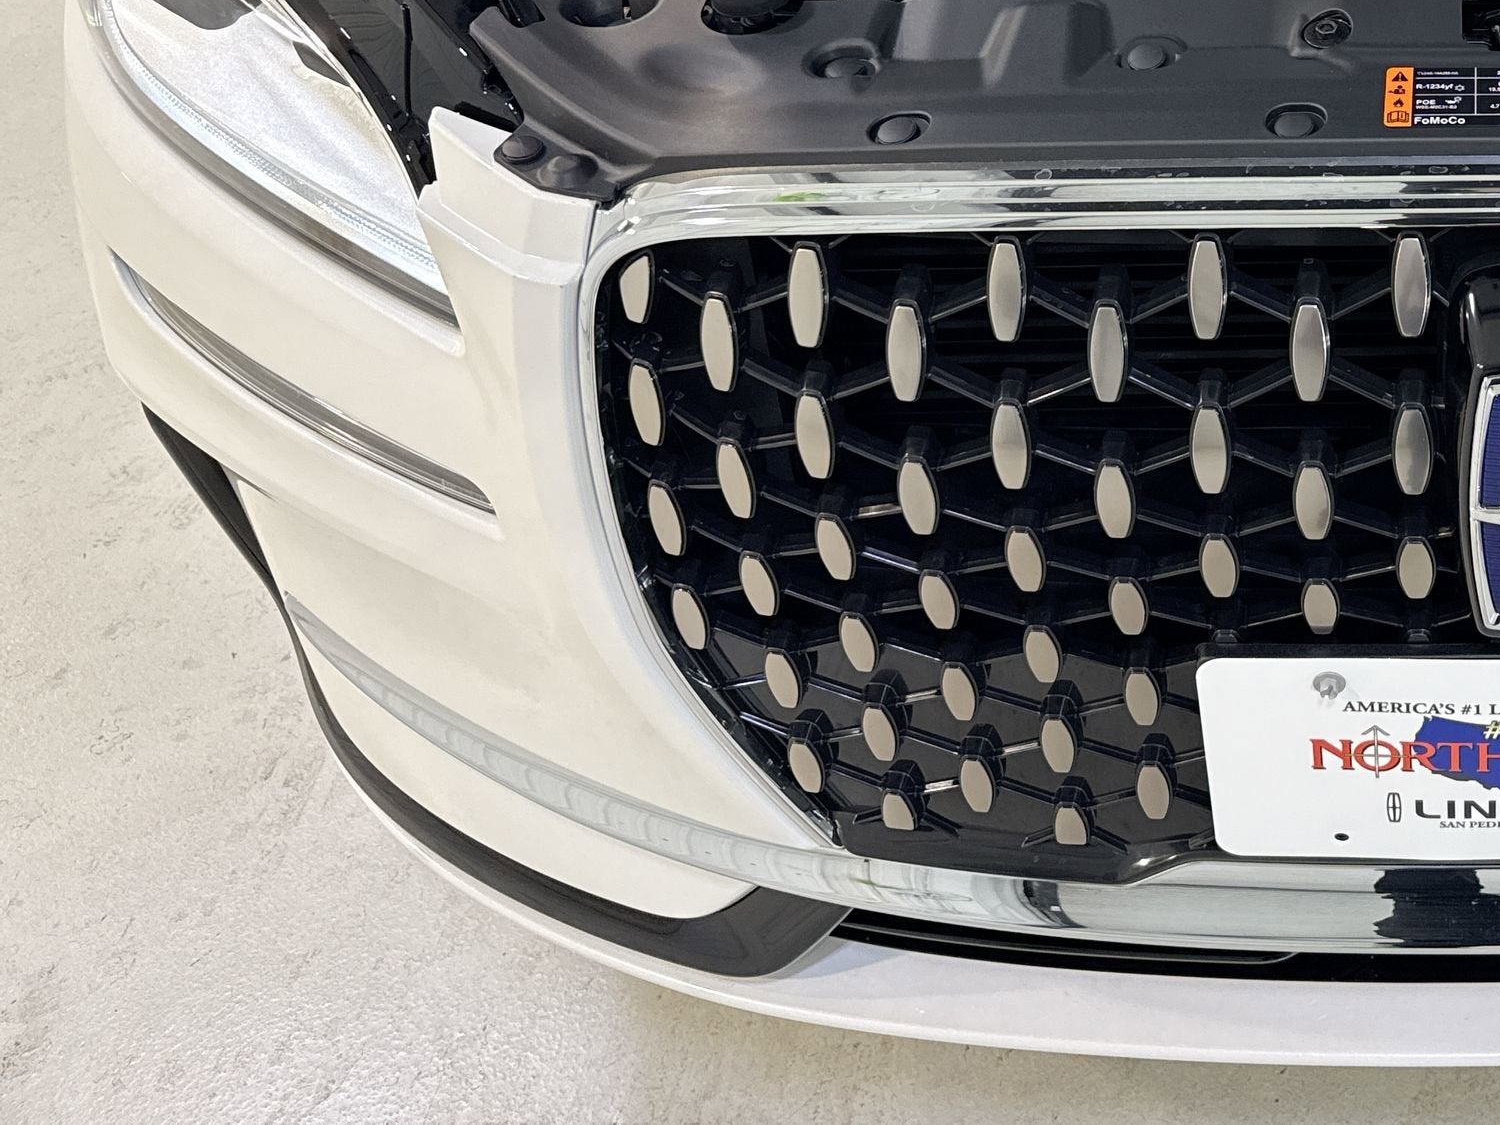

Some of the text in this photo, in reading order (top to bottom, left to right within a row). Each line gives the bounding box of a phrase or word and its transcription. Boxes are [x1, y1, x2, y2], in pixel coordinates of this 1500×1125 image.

[1415, 83, 1454, 91] R-1234yf
[1413, 116, 1466, 125] FoMoCo
[1342, 700, 1455, 715] AMERICA'S
[1461, 703, 1482, 715] #1
